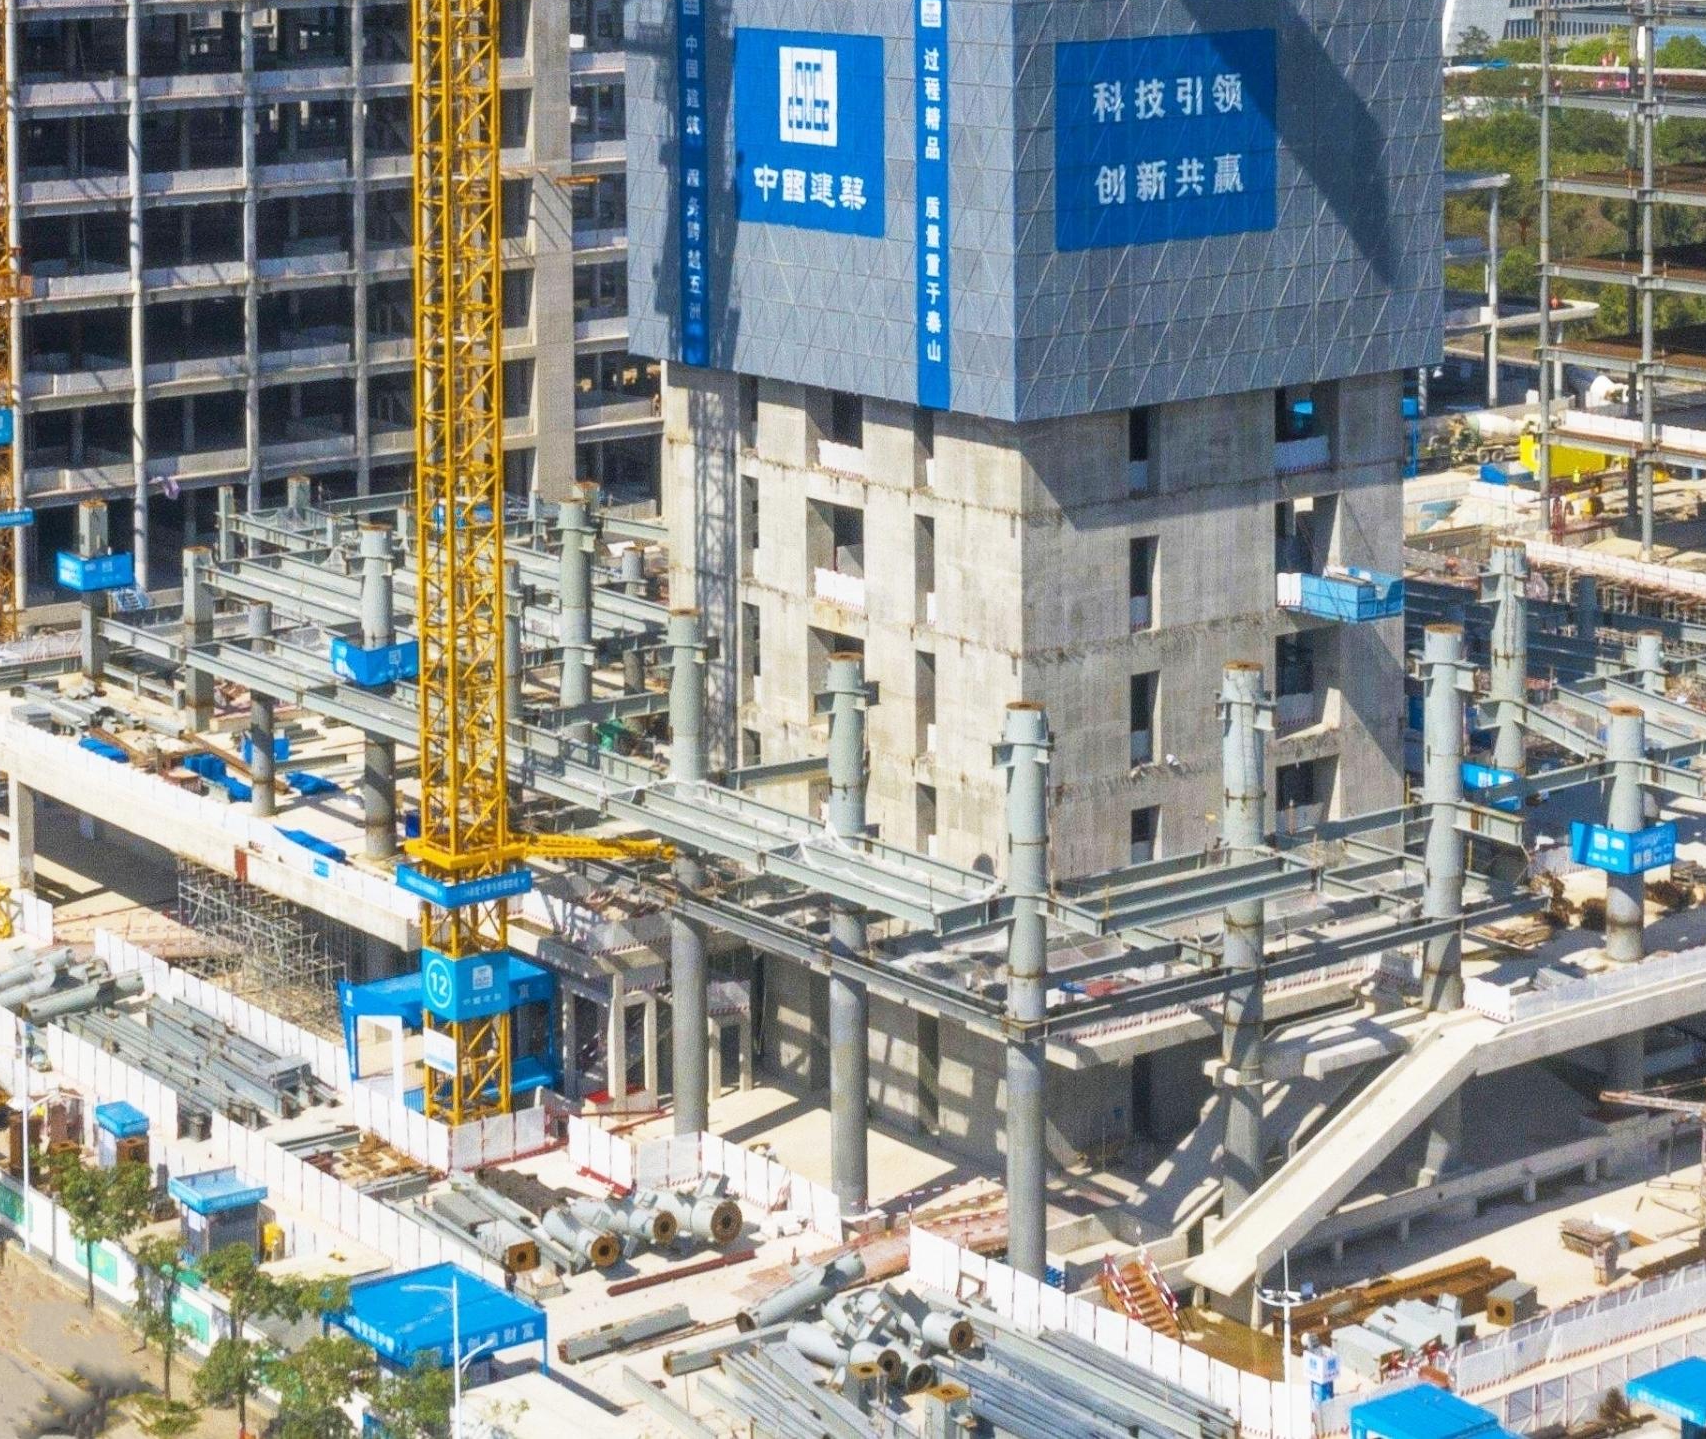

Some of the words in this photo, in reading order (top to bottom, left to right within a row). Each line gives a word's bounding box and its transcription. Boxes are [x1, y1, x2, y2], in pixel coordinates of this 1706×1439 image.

[924, 47, 941, 160] 过程精品
[1093, 73, 1243, 122] 科技引领
[753, 164, 867, 210] 中國建築
[1094, 153, 1244, 204] 创新共赢
[430, 972, 448, 998] 12
